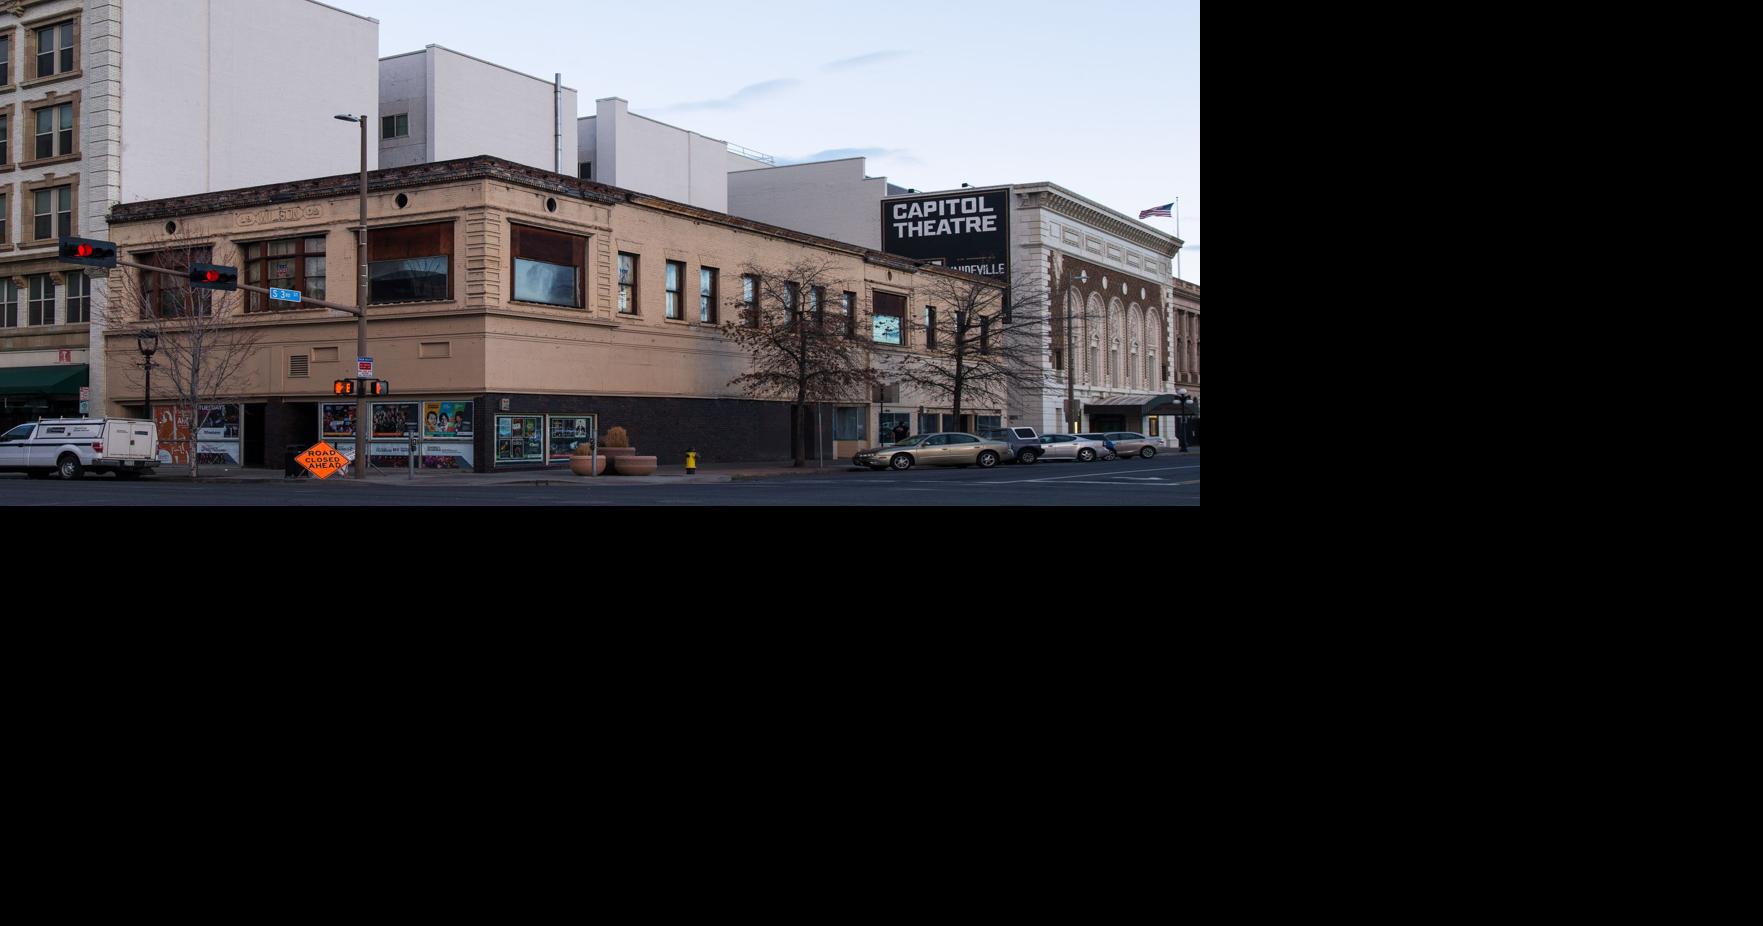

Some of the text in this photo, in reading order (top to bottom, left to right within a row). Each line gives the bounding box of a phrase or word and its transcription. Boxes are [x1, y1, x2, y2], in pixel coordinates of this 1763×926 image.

[892, 196, 994, 220] CAPITOL
[892, 215, 997, 239] THEATRE
[951, 263, 1005, 275] UDEVILLE
[272, 289, 278, 298] S
